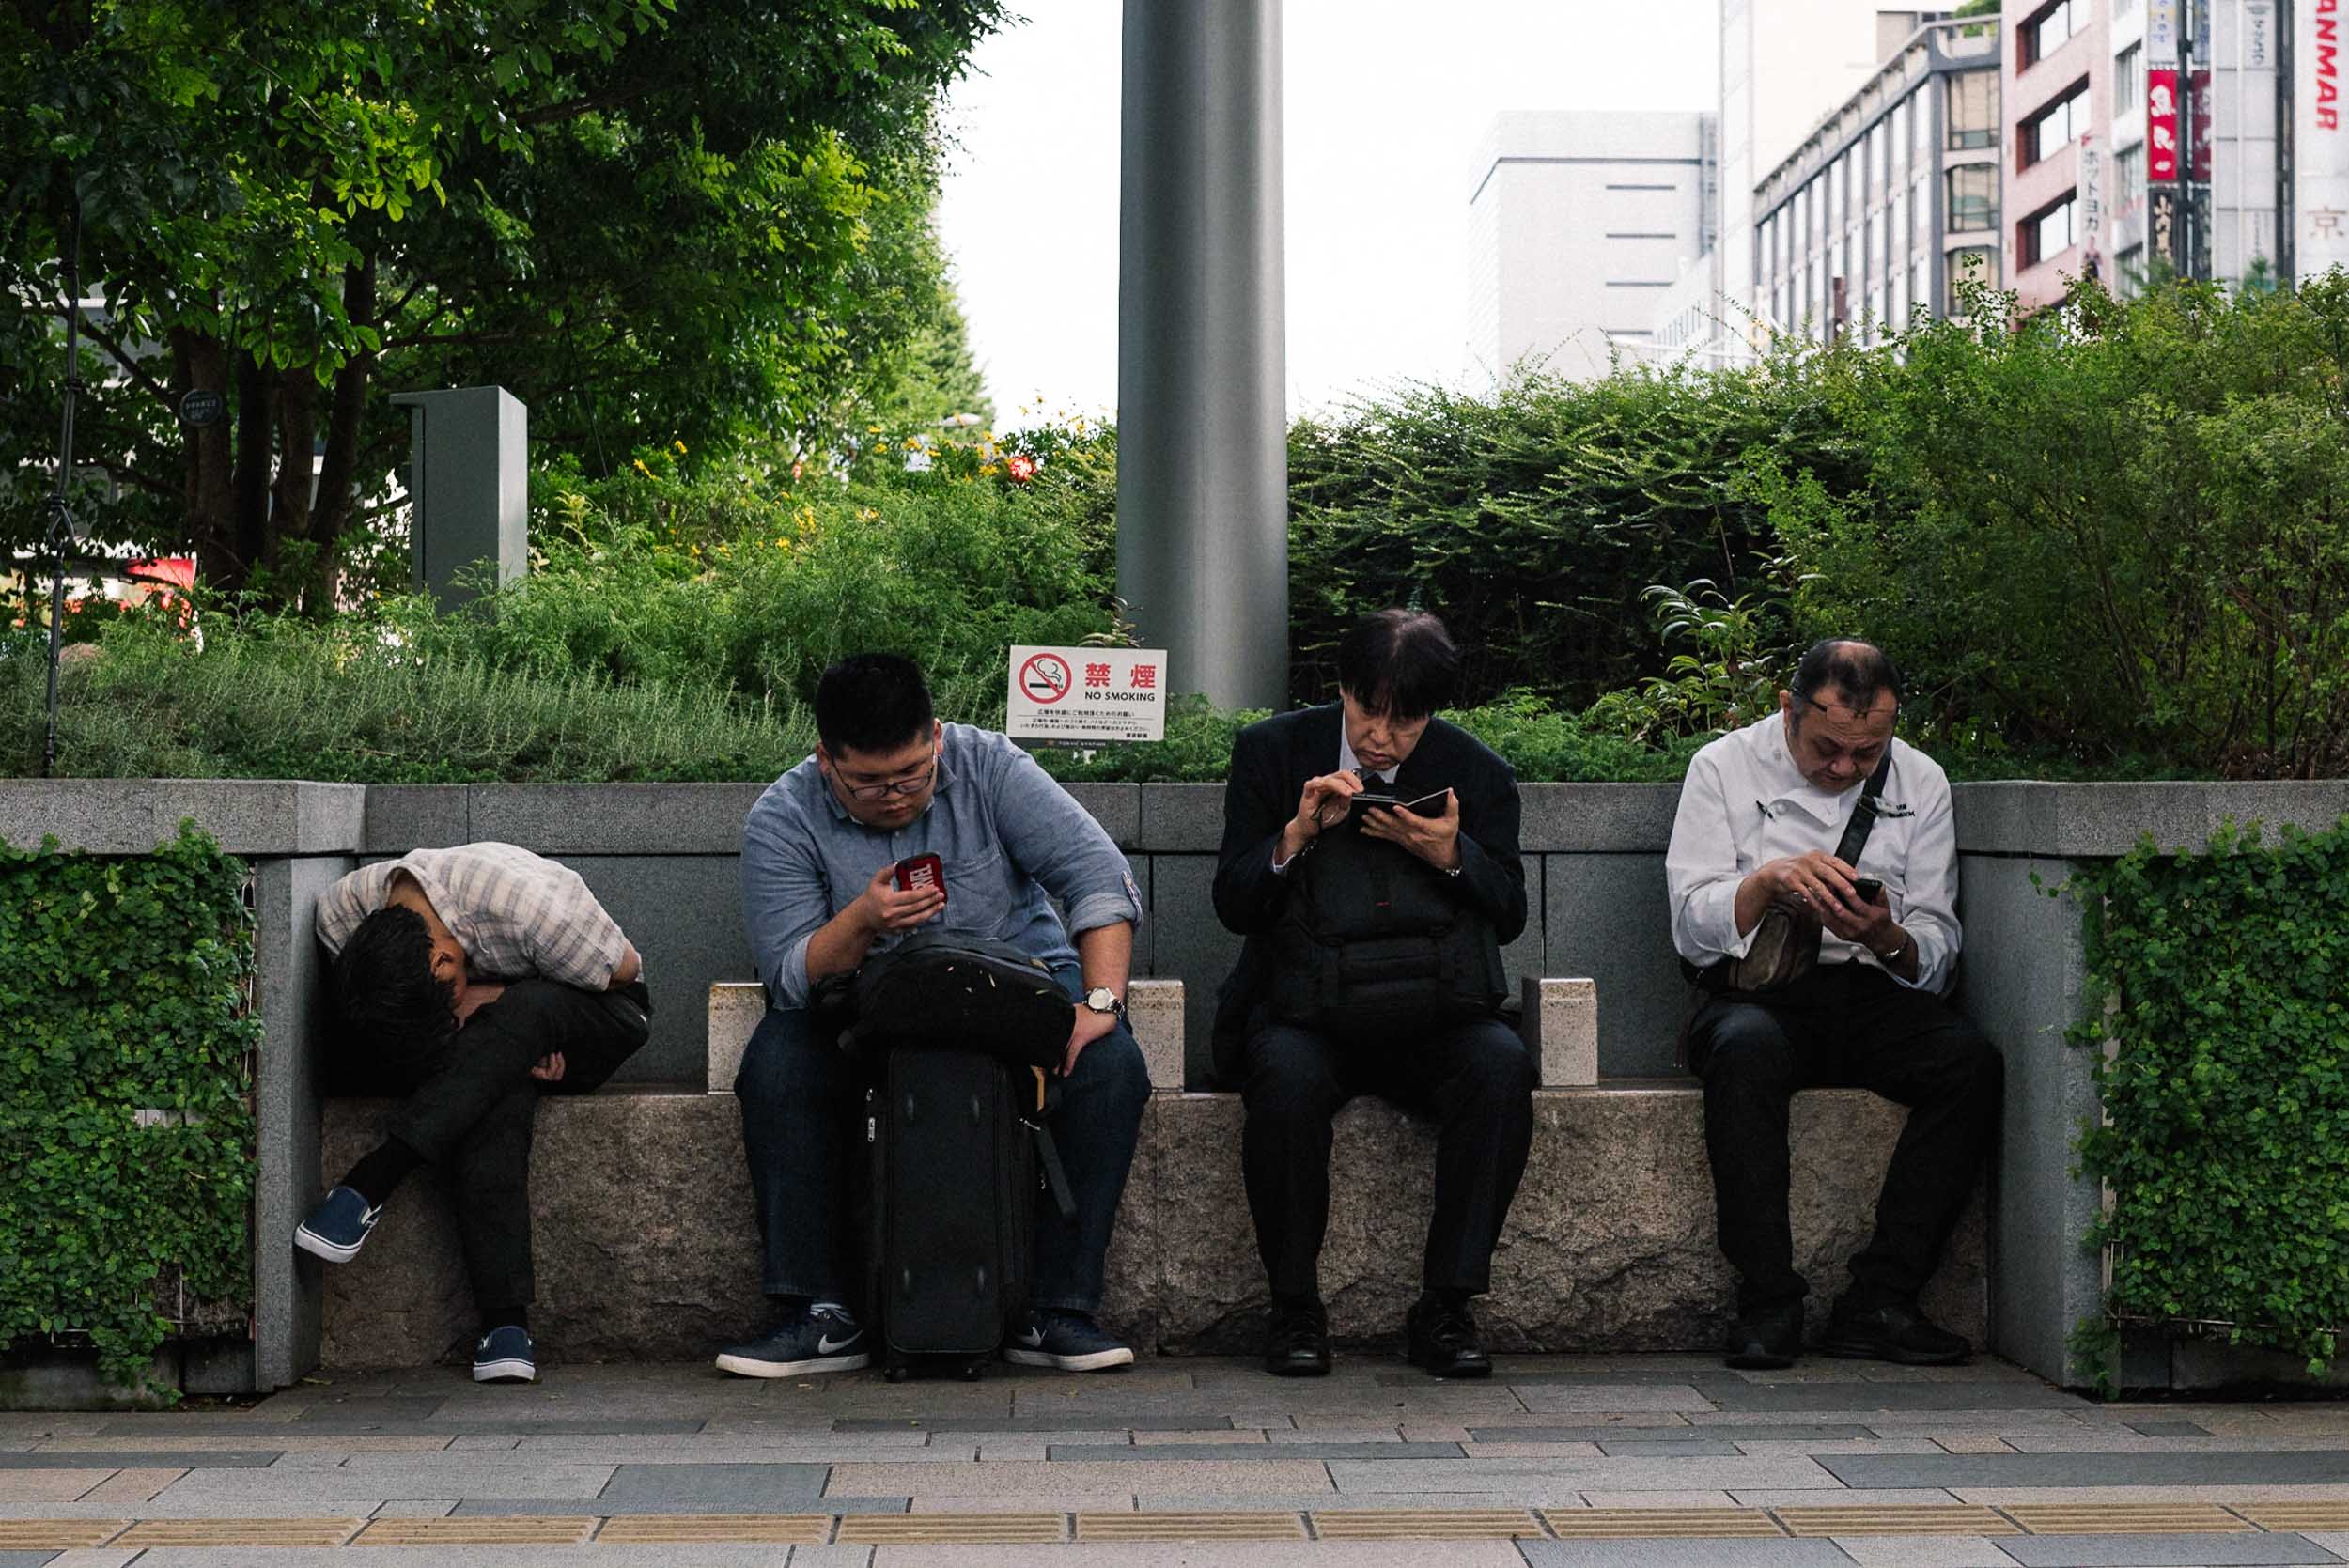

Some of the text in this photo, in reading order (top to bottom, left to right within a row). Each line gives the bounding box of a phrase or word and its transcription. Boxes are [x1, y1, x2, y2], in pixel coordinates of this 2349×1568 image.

[1085, 662, 1156, 688] 禁煙
[1084, 691, 1156, 702] NO SMOKING
